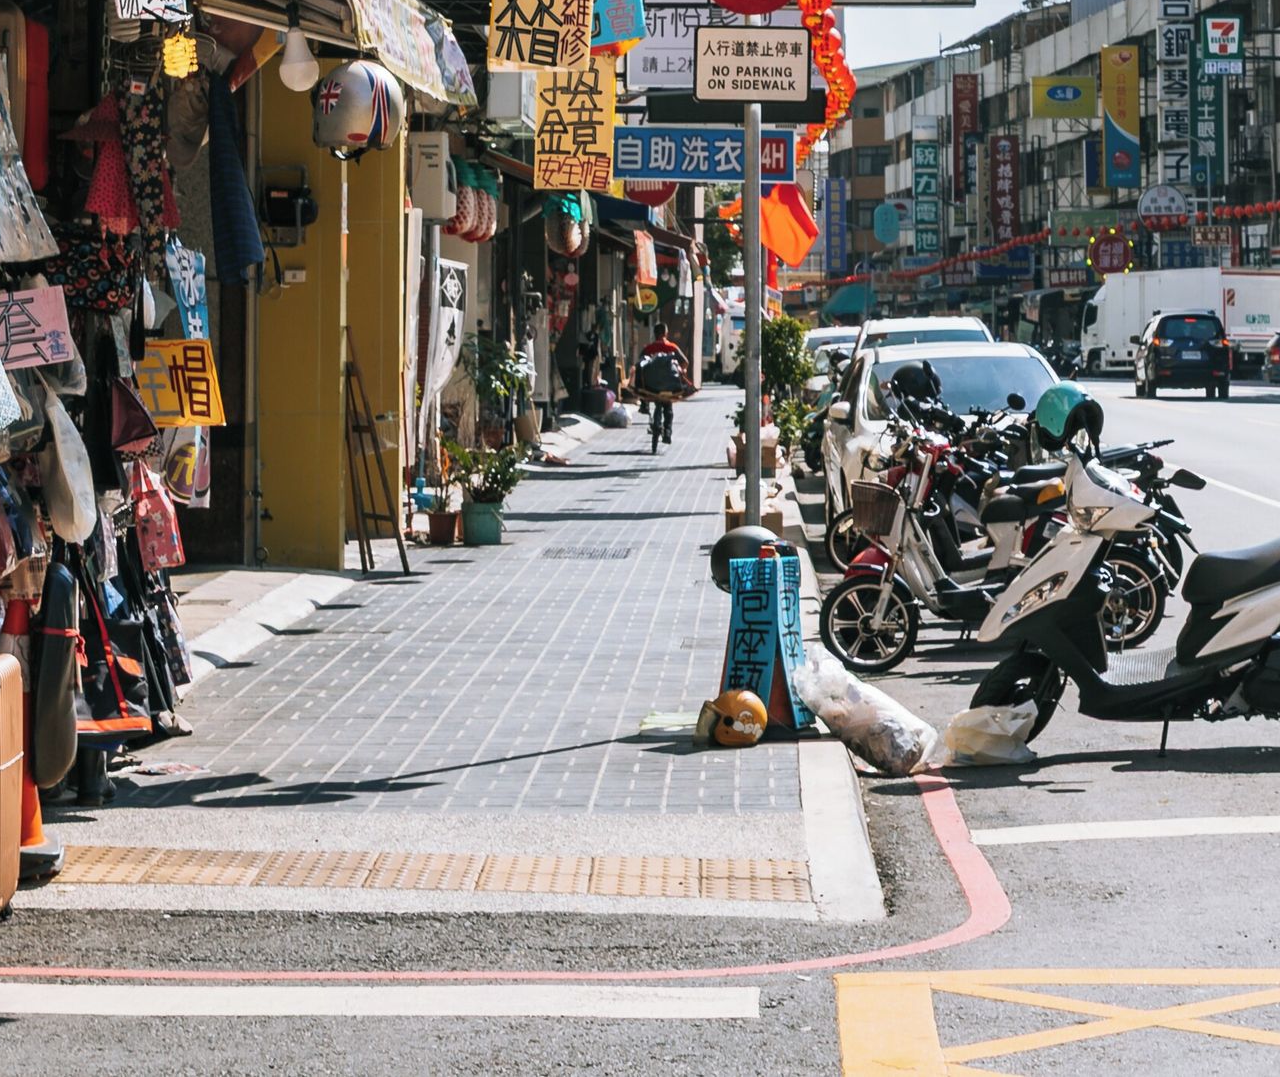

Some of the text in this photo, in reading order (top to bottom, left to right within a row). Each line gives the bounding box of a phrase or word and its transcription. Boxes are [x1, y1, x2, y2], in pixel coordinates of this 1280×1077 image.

[702, 39, 804, 58] 人行道禁止停車
[712, 65, 793, 79] NO PARKING
[707, 79, 797, 92] ON SIDEWALK
[619, 134, 744, 173] 自助洗衣
